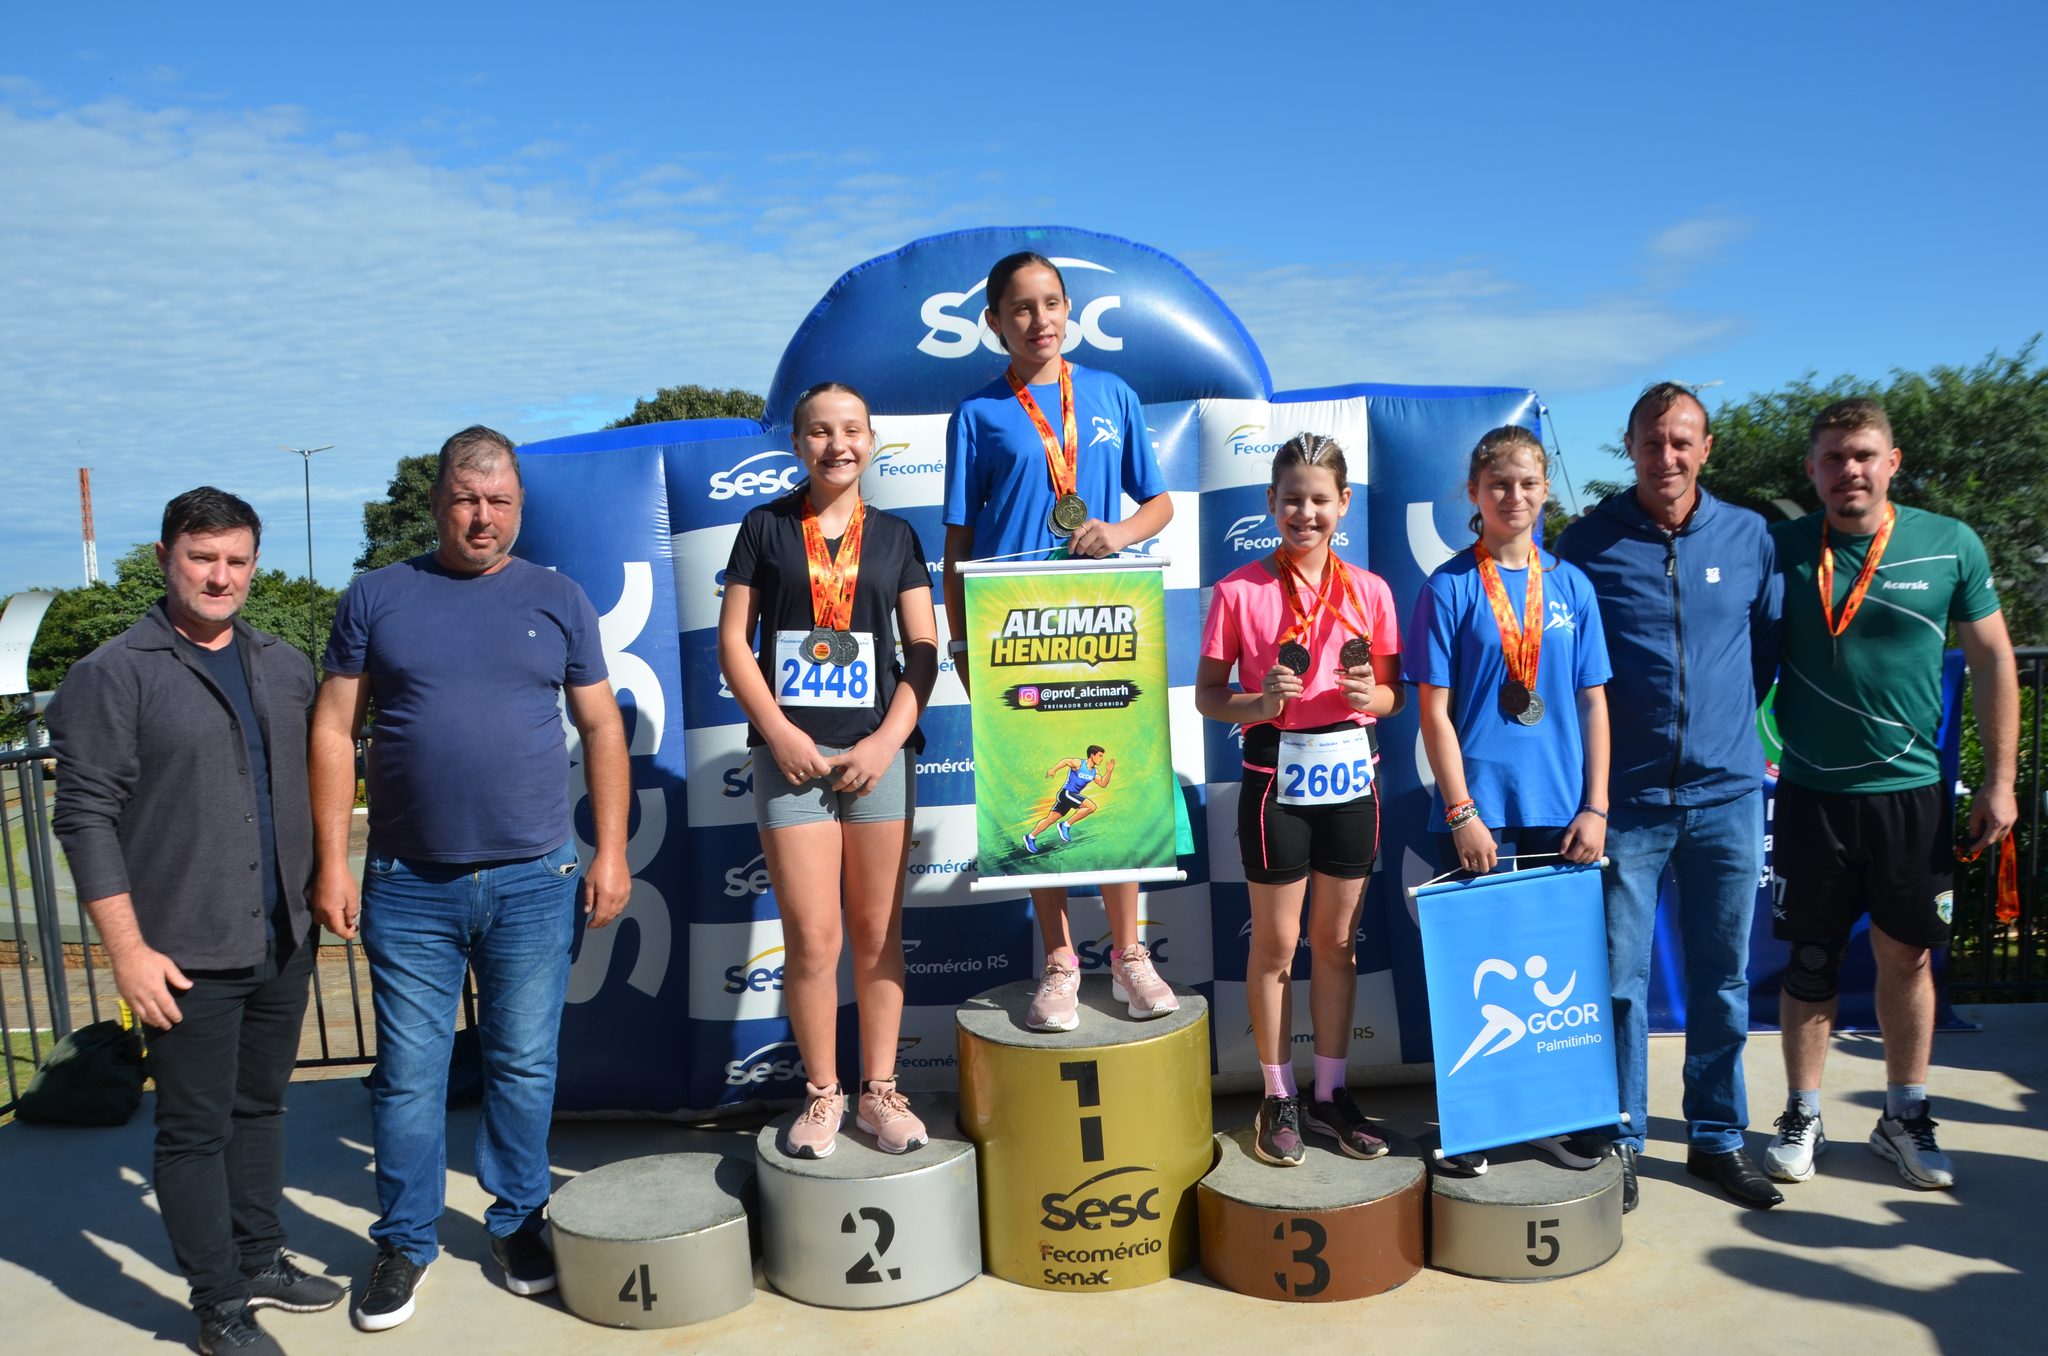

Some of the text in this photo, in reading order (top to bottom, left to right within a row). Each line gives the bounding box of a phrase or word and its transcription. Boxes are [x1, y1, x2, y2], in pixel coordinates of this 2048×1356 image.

[917, 292, 1123, 359] Sc
[708, 466, 798, 500] Sesc
[879, 459, 944, 477] Fecomé
[1004, 606, 1133, 637] ALCIMAR
[994, 634, 1134, 664] HENRIQUE
[781, 658, 868, 699] 2448
[1041, 685, 1129, 700] @prof_alcimarh
[915, 759, 976, 774] omérci
[1284, 759, 1371, 798] 2605
[724, 867, 771, 897] Se
[904, 954, 1008, 974] ecomércio RS
[724, 965, 784, 995] Ses
[1354, 1026, 1374, 1040] RS
[1528, 1003, 1599, 1034] GCOR
[1537, 1033, 1602, 1053] Palmitinho
[1059, 1059, 1104, 1163] 1
[1040, 1187, 1160, 1231] Sesc
[840, 1206, 901, 1284] 2
[1041, 1237, 1161, 1263] Fecomércio
[1273, 1218, 1331, 1297] 3
[1526, 1219, 1560, 1267] 5
[618, 1264, 657, 1311] 4
[1043, 1269, 1109, 1285] Senac
